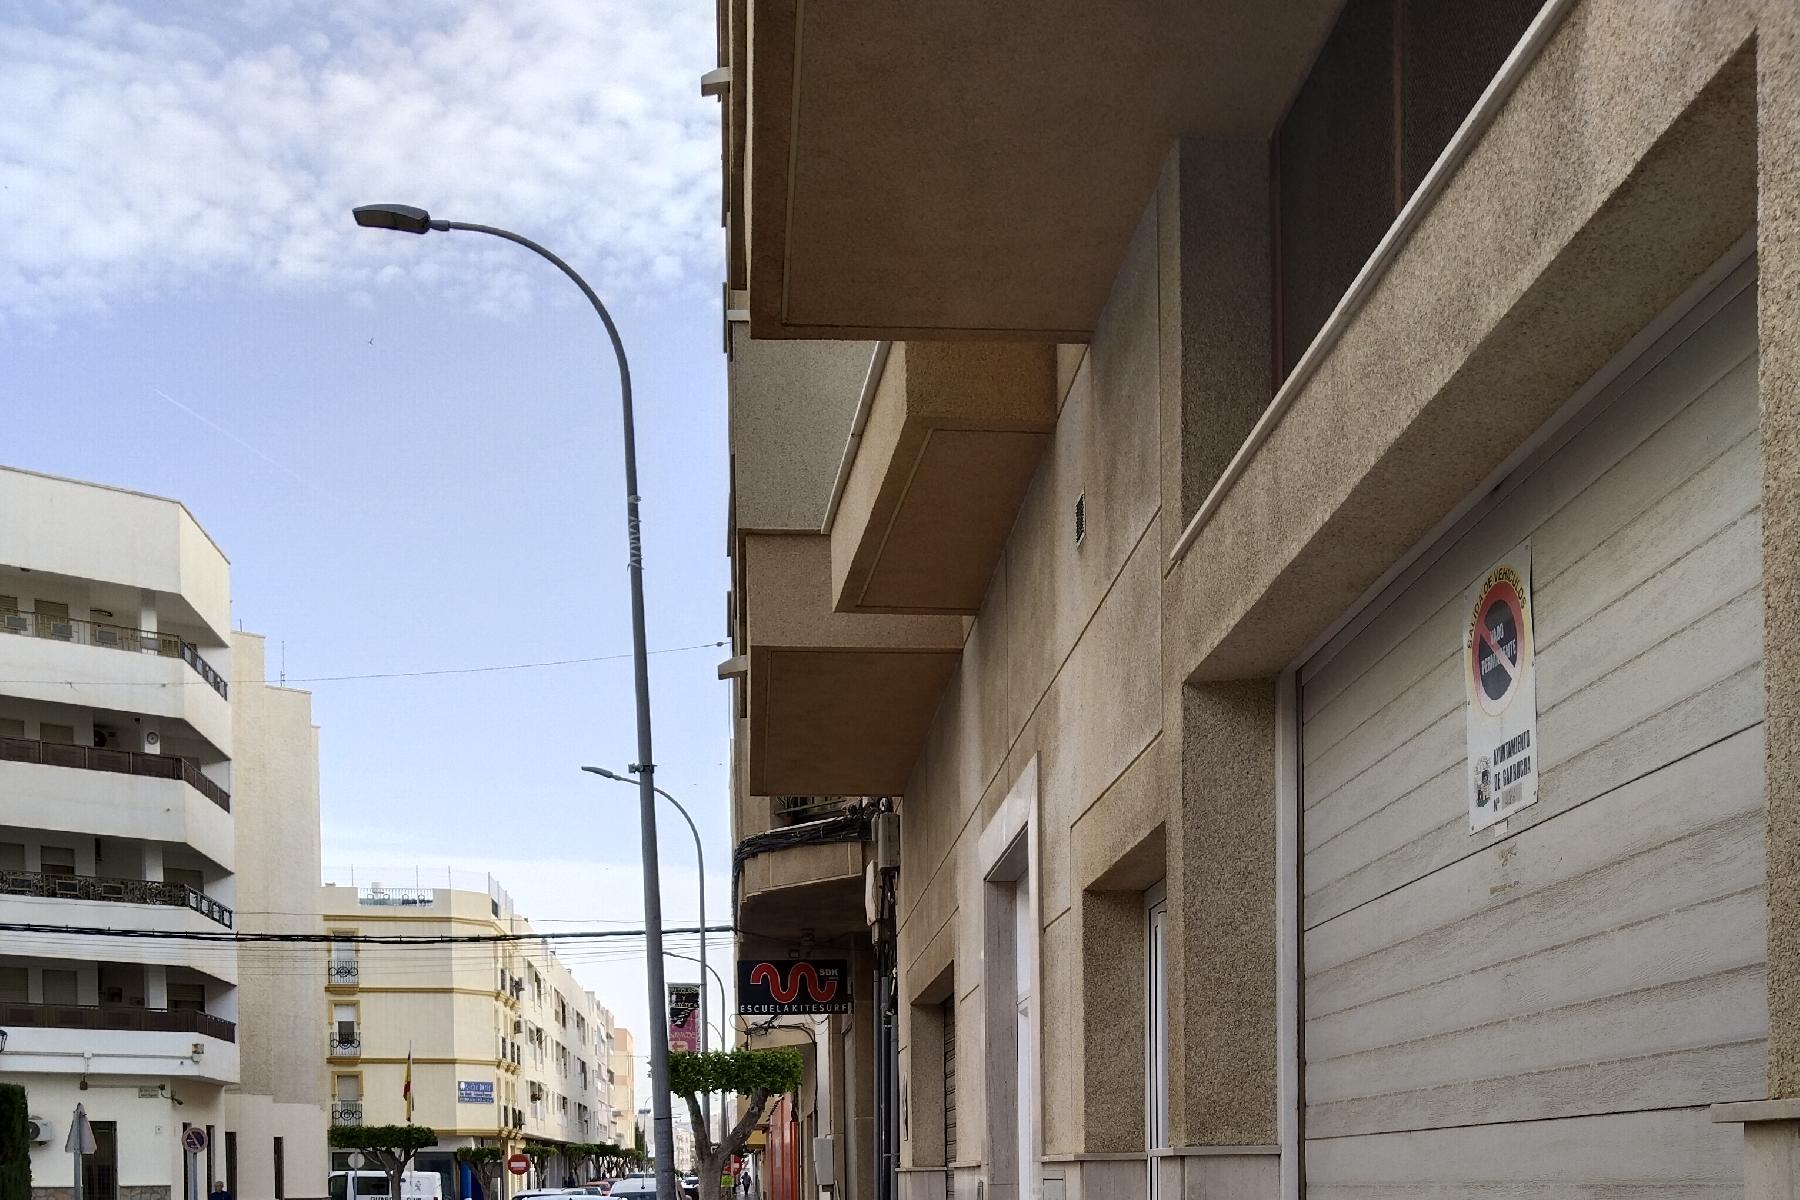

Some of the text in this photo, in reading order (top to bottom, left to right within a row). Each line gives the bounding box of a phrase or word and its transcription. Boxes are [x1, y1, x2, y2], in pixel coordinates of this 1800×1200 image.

[1467, 594, 1484, 649] SALIDA
[1483, 576, 1493, 594] DE
[1481, 638, 1516, 676] PERMENTE
[1494, 772, 1501, 791] DE
